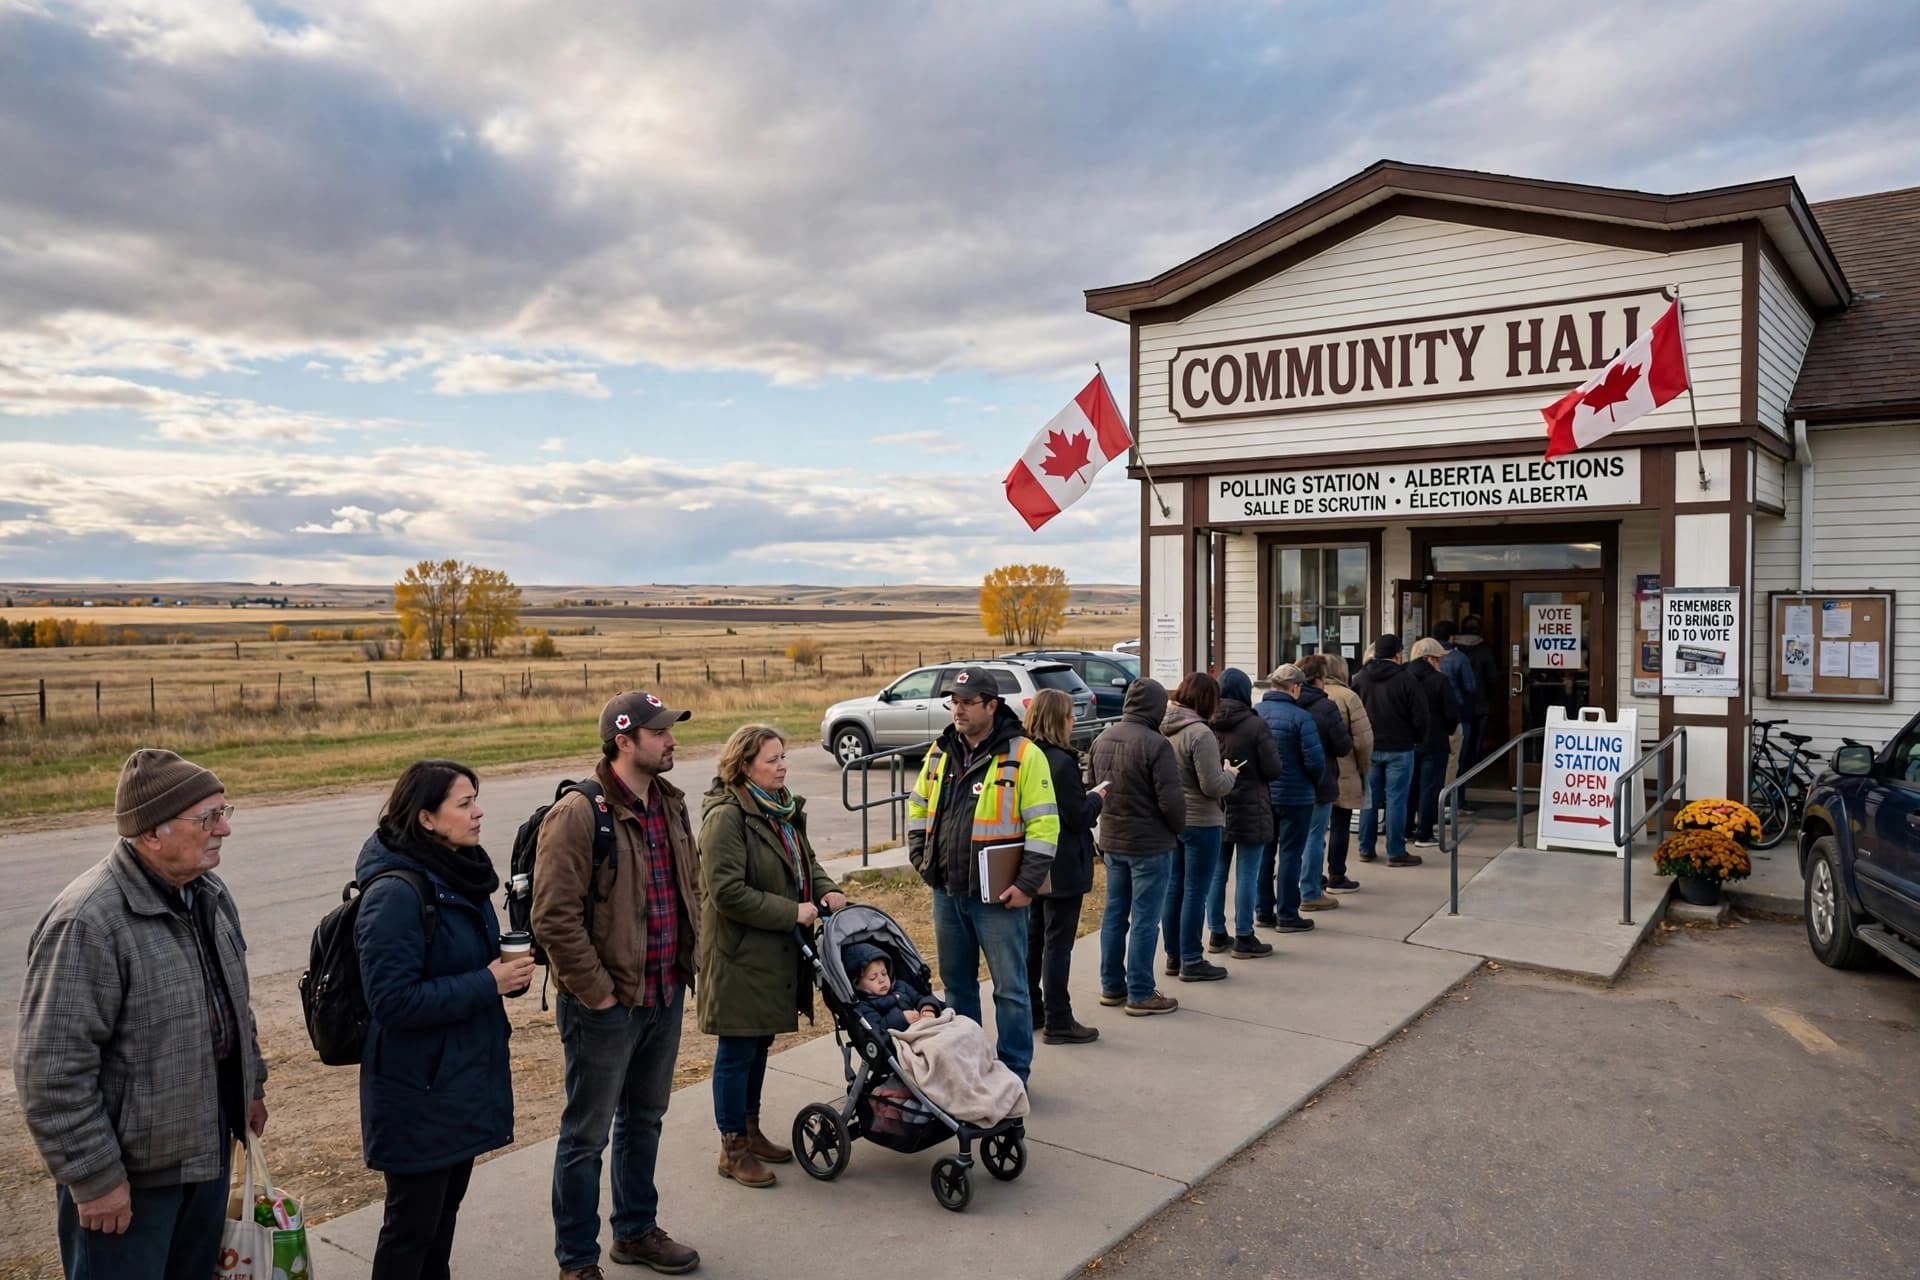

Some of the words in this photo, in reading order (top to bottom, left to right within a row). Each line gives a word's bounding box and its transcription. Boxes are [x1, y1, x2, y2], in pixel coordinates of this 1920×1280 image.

[1182, 324, 1485, 409] COMMUNITY
[1220, 477, 1296, 499] POLLING
[1302, 471, 1380, 494] STATION
[1405, 465, 1496, 488] ALBERTA
[1502, 456, 1624, 483] ELECTIONS
[1244, 501, 1289, 516] SALLE
[1294, 499, 1314, 514] DE
[1318, 495, 1387, 513] SCRUTIN
[1410, 489, 1502, 508] ÉLECTIONS
[1508, 484, 1588, 504] ALBERTA
[1669, 600, 1732, 612] REMEMBER
[1538, 608, 1572, 621] VOTE
[1667, 614, 1682, 626] TO
[1685, 614, 1719, 627] BRING
[1723, 614, 1735, 627] ID
[1538, 623, 1573, 635] HERE
[1668, 629, 1679, 641] ID
[1682, 629, 1697, 641] TO
[1700, 629, 1730, 641] VOTE
[1534, 637, 1577, 651] VOTEZ
[1547, 653, 1564, 667] ICI
[1555, 734, 1622, 753] POLLING
[1554, 753, 1620, 772] STATION
[1565, 773, 1607, 790] OPEN
